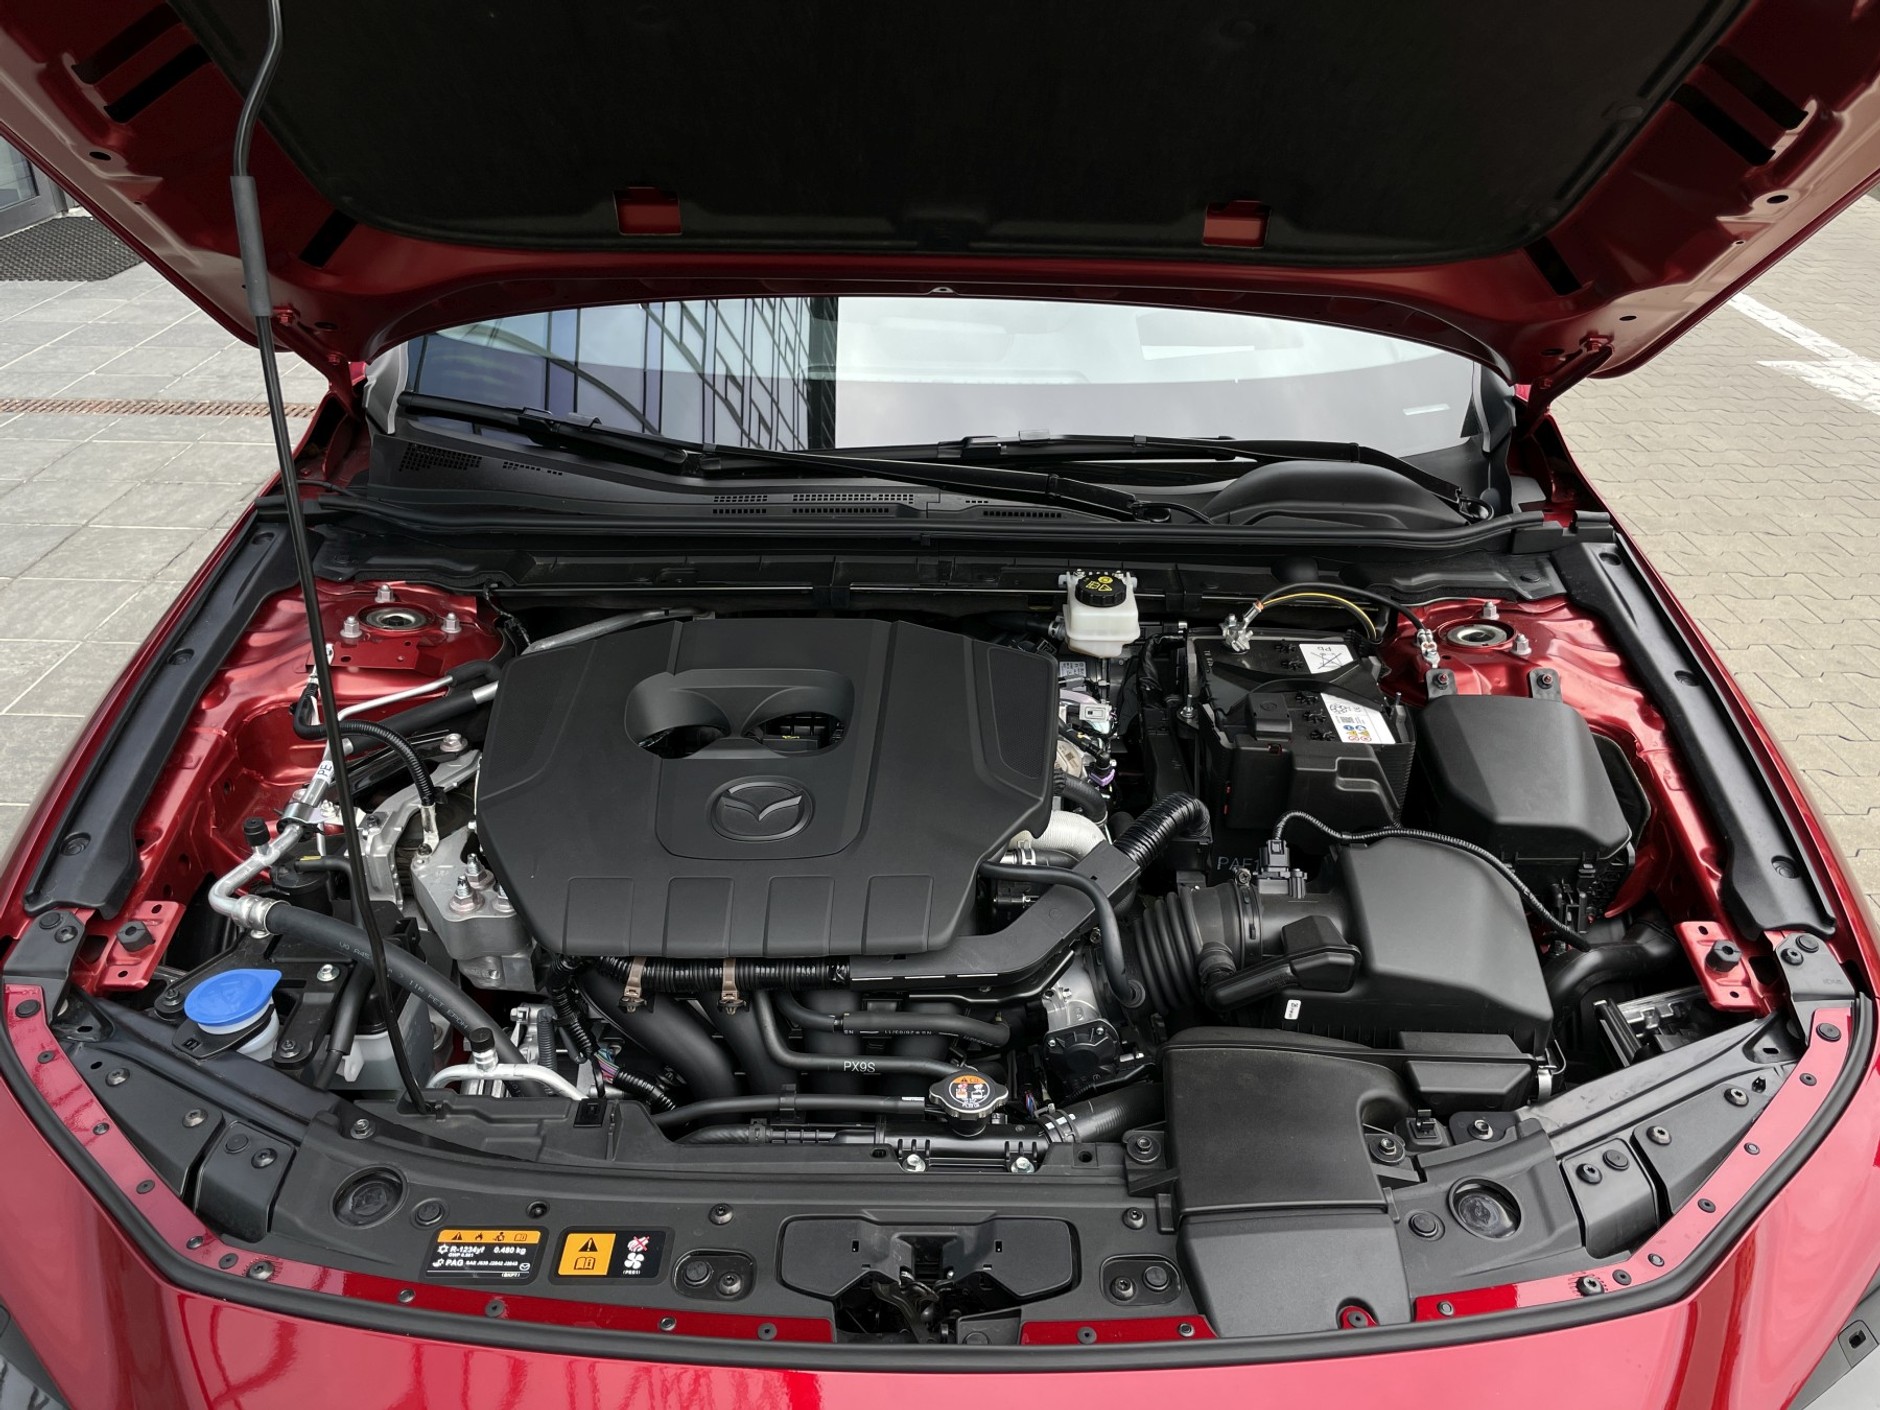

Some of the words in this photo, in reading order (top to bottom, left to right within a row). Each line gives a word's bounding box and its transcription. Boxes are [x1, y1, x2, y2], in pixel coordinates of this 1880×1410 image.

[317, 764, 333, 777] PE
[843, 1060, 876, 1073] PX9S
[449, 1246, 485, 1254] R-1234yf
[515, 1246, 527, 1255] kg
